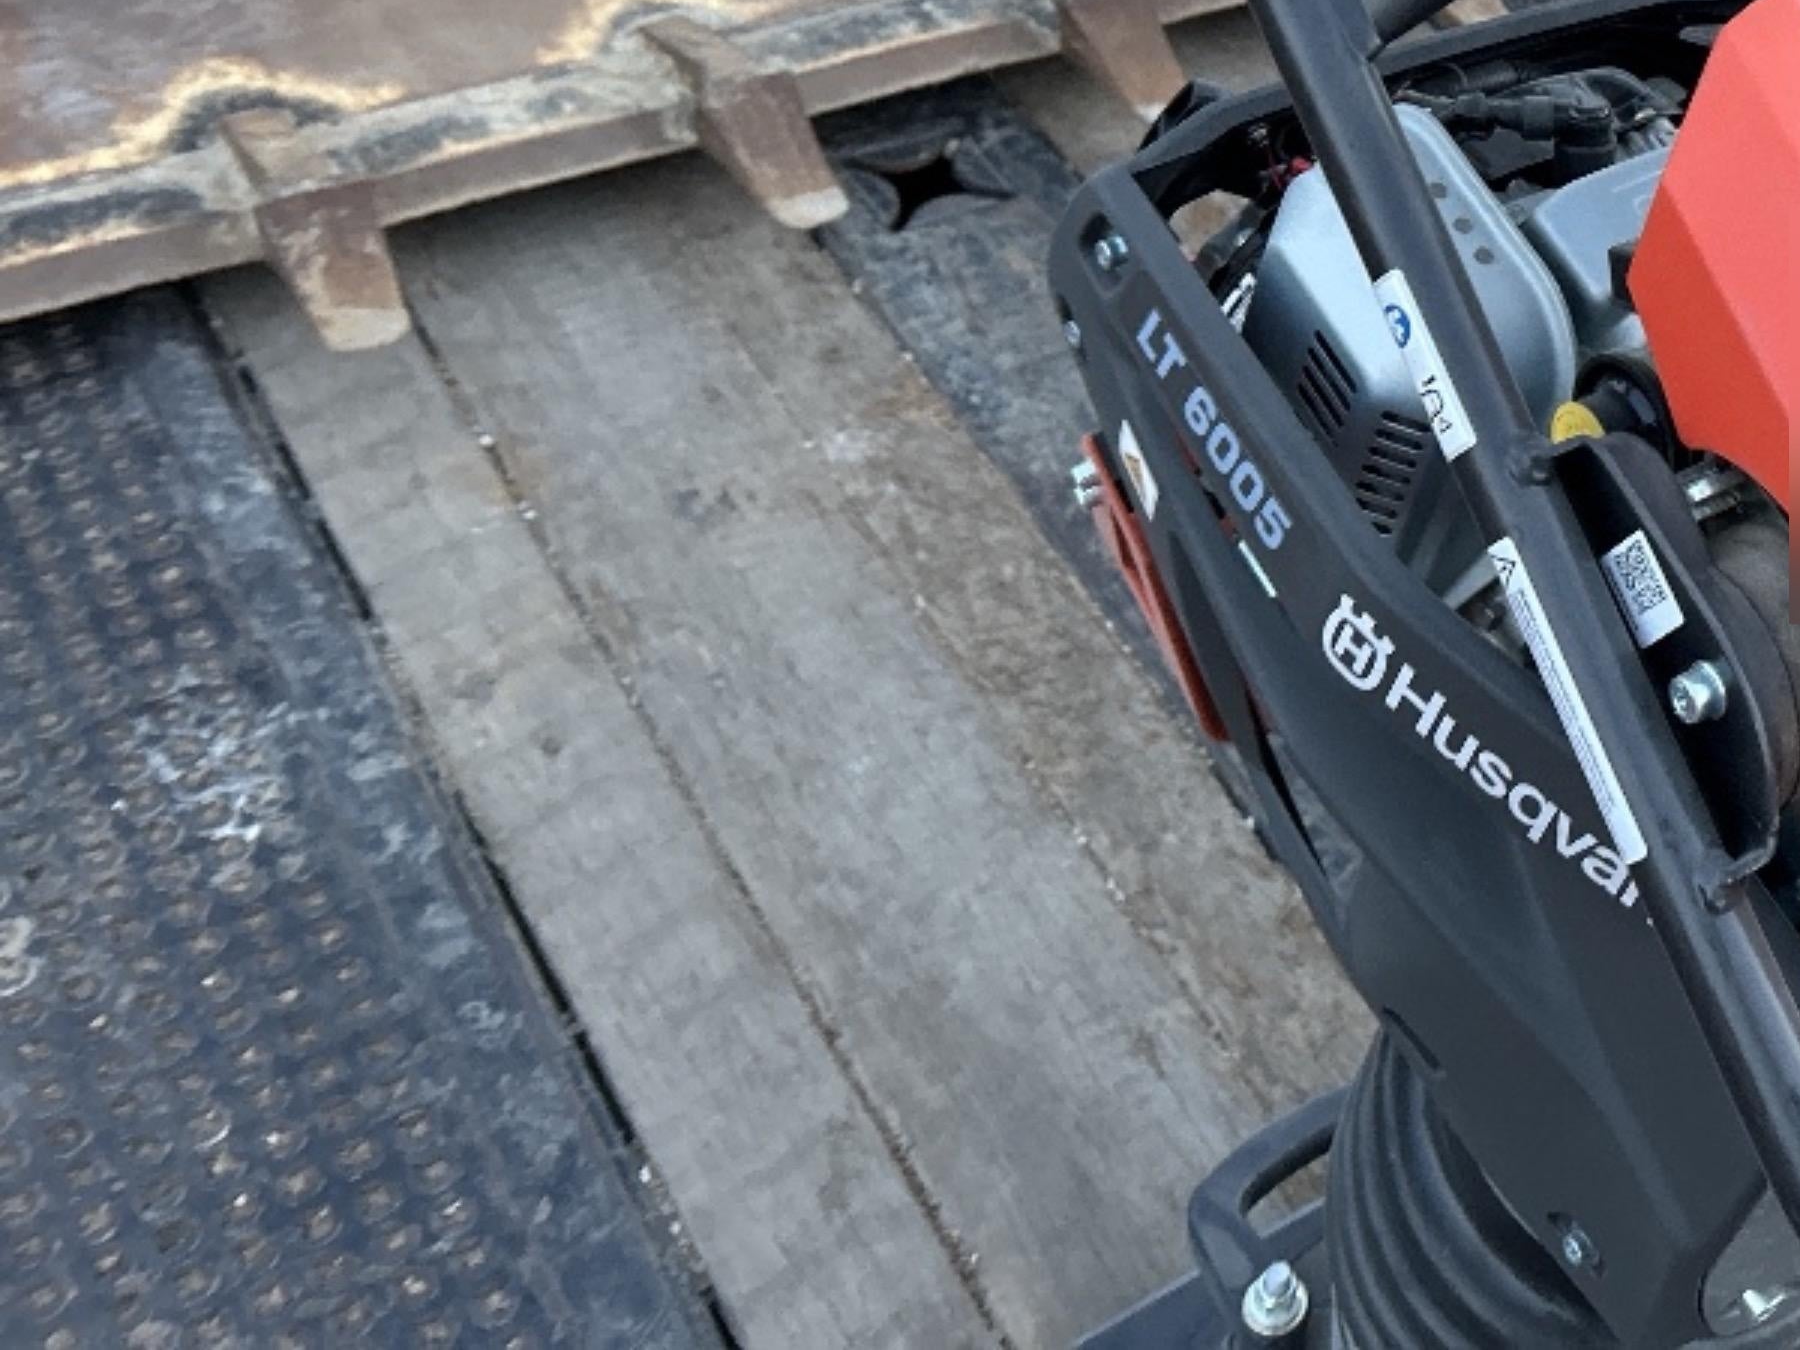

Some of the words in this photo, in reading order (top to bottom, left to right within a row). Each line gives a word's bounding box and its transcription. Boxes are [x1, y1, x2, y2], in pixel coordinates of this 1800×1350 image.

[1135, 306, 1188, 380] LT
[1183, 385, 1293, 550] 6005
[1384, 661, 1655, 926] Husqva
